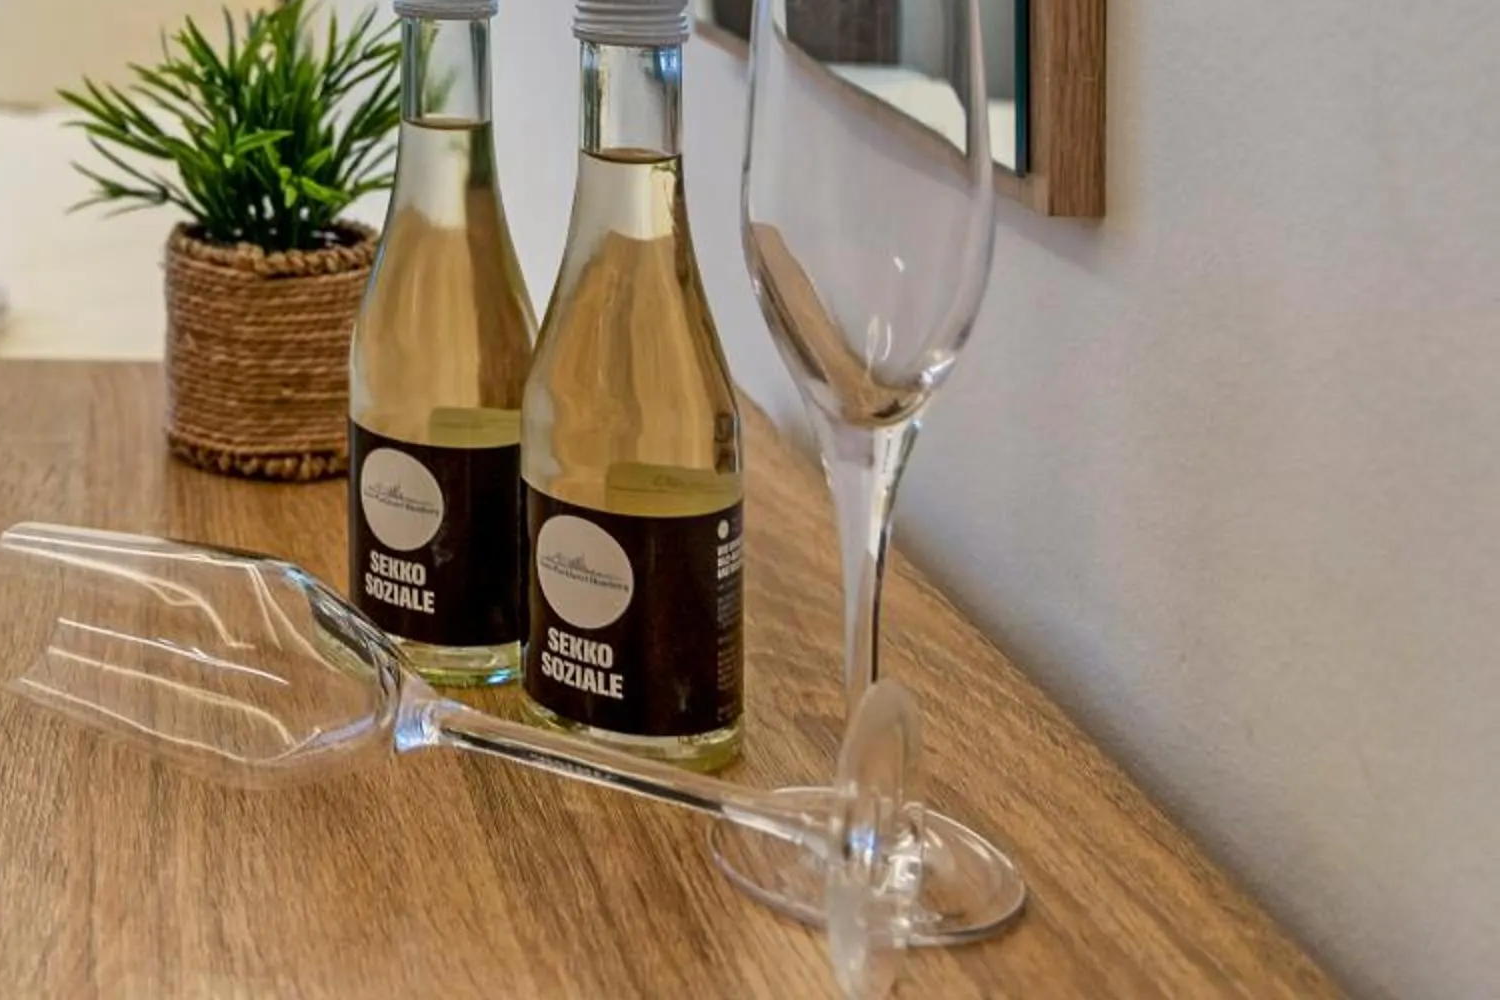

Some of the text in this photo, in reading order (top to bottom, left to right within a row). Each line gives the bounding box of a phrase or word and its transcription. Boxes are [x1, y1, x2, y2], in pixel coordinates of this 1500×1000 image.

[370, 549, 426, 585] SEKKO
[365, 573, 435, 613] SOZIALE
[548, 627, 613, 669] SEKKO
[542, 652, 623, 699] SOZIALE
